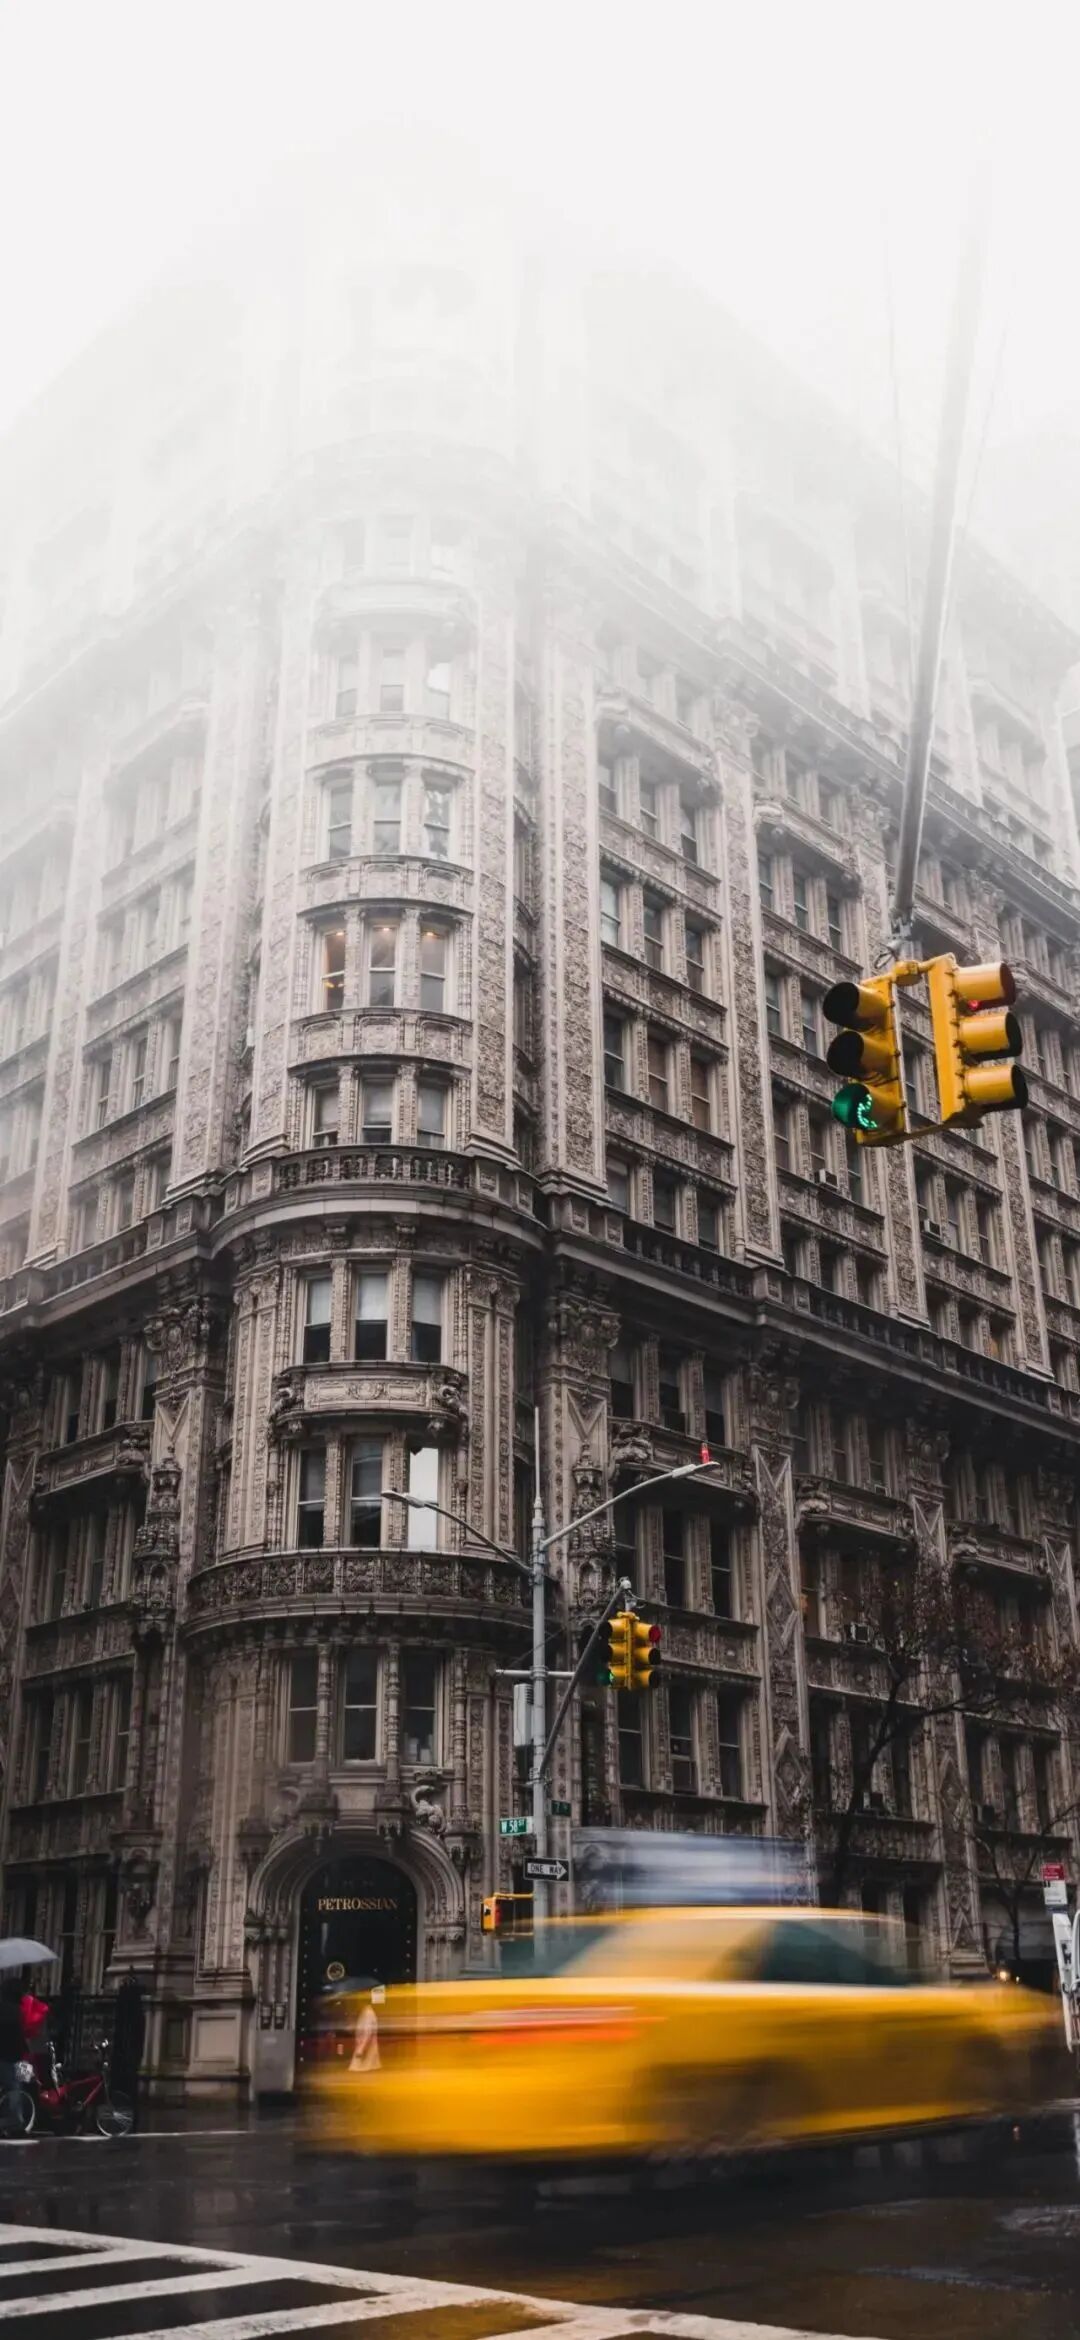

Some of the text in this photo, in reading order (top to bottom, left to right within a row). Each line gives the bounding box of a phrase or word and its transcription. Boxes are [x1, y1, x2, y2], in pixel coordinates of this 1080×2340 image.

[530, 1863, 563, 1875] ONE WAY
[318, 1898, 398, 1910] PETROSSIAN
